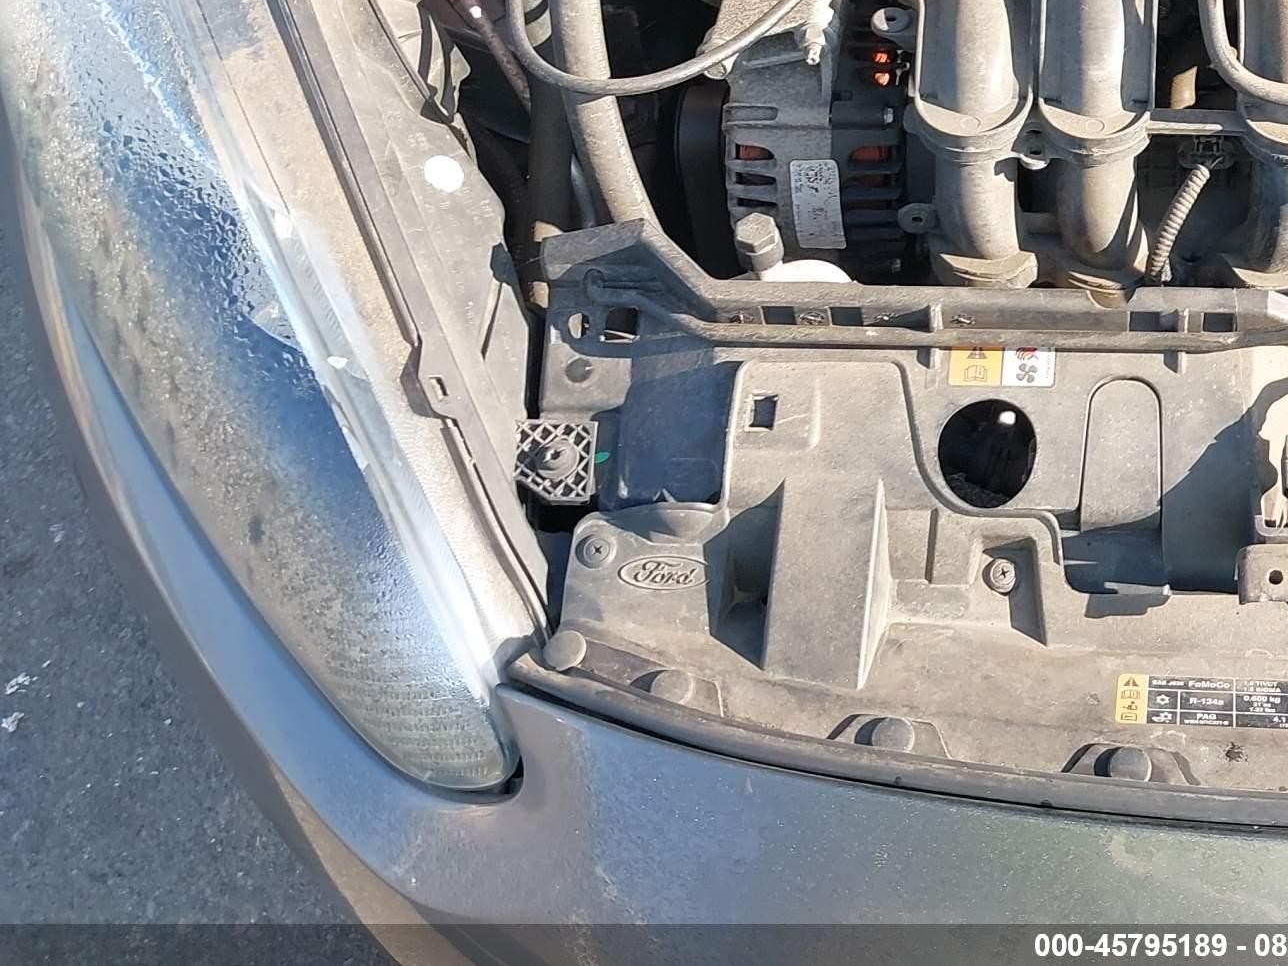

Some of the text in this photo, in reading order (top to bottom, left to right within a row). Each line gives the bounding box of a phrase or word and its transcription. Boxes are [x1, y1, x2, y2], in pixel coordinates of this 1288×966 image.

[632, 560, 698, 586] Ford
[1188, 680, 1230, 689] FoMoCo
[1189, 697, 1225, 706] R-134a
[1269, 696, 1281, 704] kg
